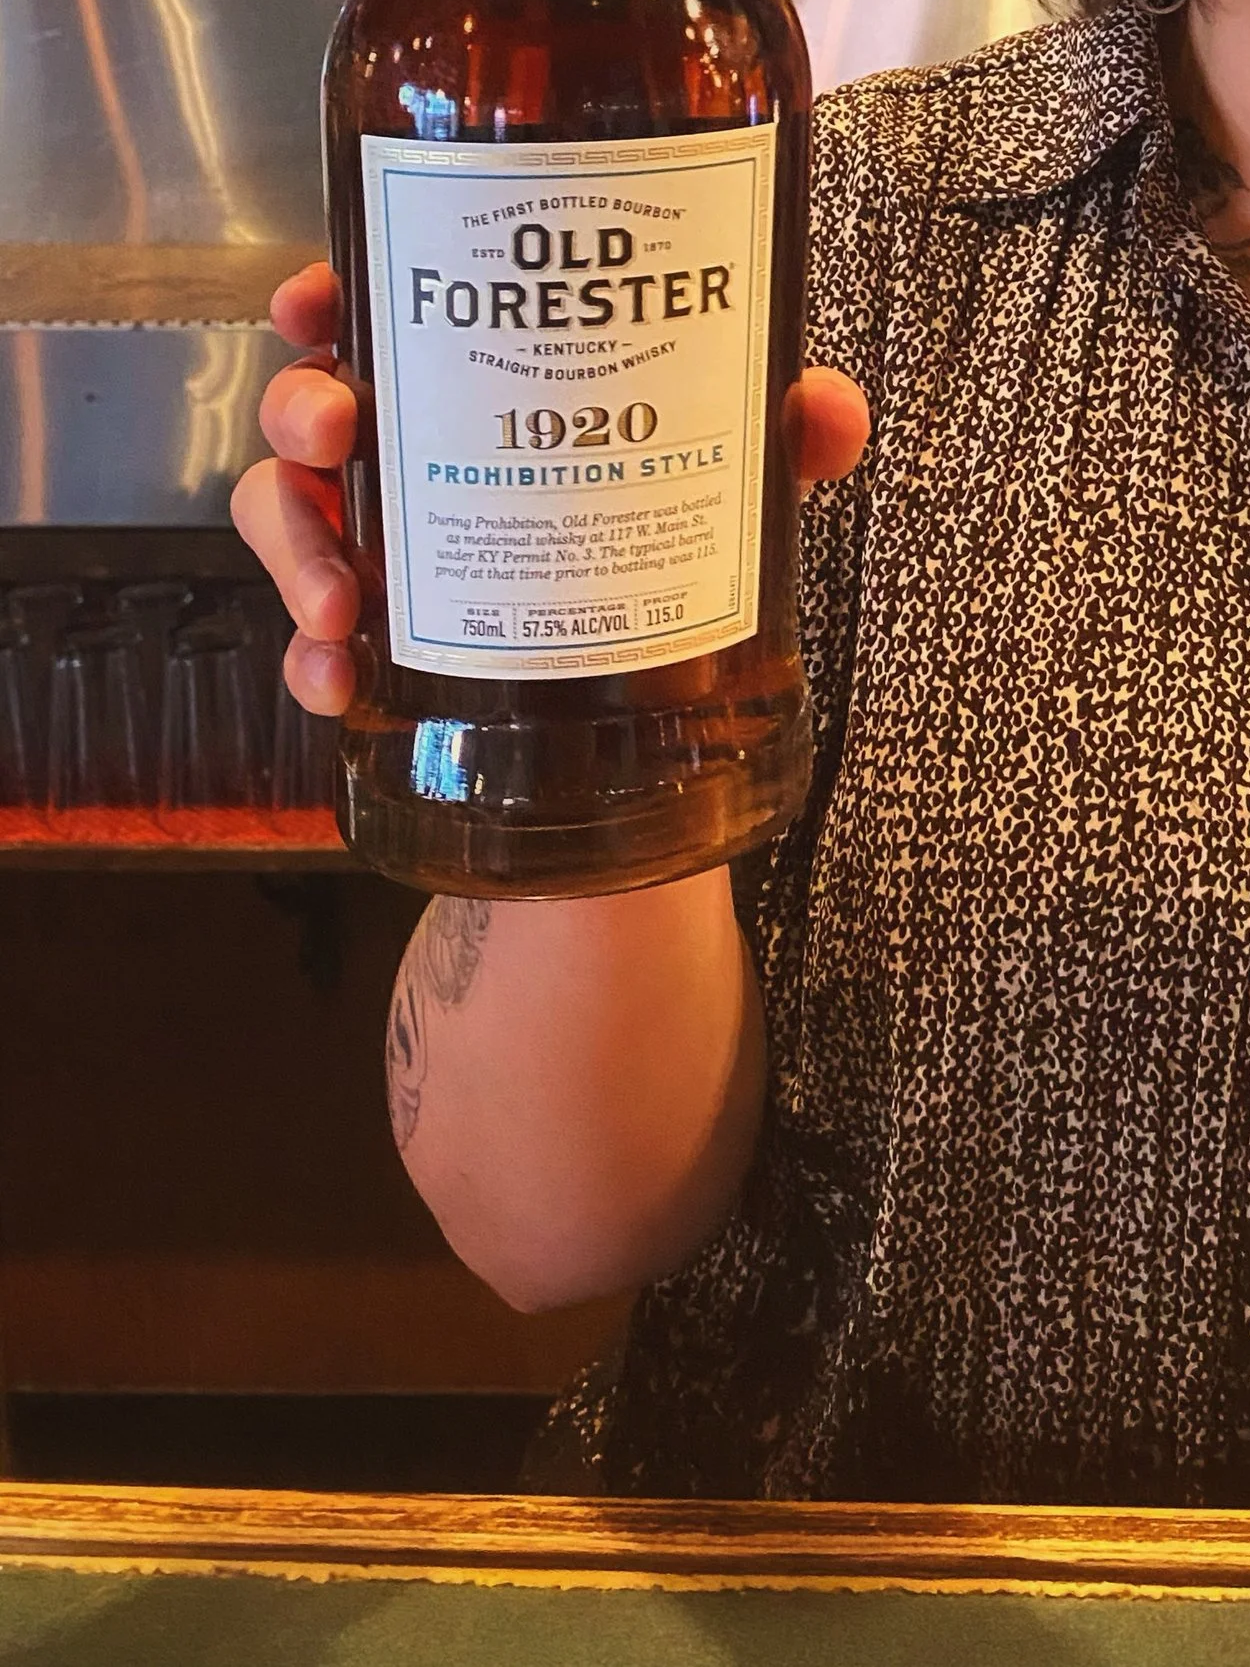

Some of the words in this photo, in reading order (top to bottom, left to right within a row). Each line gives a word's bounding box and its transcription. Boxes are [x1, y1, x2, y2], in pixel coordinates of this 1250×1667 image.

[461, 212, 491, 229] THE
[493, 200, 535, 223] FIRST
[539, 195, 608, 211] BOTTLED
[612, 198, 682, 222] BOURBON
[511, 221, 634, 272] OLD
[408, 264, 732, 330] FORESTER
[468, 350, 541, 380] STRAIGHT
[543, 361, 619, 381] BOURBON
[620, 340, 678, 370] WHISKY
[532, 339, 620, 357] KENTUCKY
[494, 401, 659, 451] 1920
[426, 460, 625, 487] PROHIBITION
[639, 443, 725, 479] STYLE
[427, 510, 472, 531] During
[474, 514, 558, 531] Prohibition,
[561, 513, 588, 529] Old
[591, 509, 651, 527] Forester
[652, 504, 678, 519] was
[681, 491, 722, 514] bottled
[435, 548, 475, 562] under
[477, 548, 499, 564] KY
[502, 549, 551, 564] Permit
[599, 545, 627, 560] The
[629, 537, 677, 558] typical
[678, 526, 715, 548] barrel
[446, 533, 460, 545] as
[463, 533, 532, 547] medicinal
[535, 531, 586, 548] whisky
[589, 530, 604, 544] at
[654, 517, 689, 536] Main
[434, 564, 470, 581] proof
[470, 566, 483, 580] at
[486, 566, 515, 581] that
[518, 566, 551, 580] time
[553, 563, 590, 582] prior
[593, 563, 609, 577] to
[611, 555, 666, 575] bottling
[668, 551, 694, 565] was
[522, 619, 568, 639] 57.5%
[570, 611, 631, 636] ALC/VOL
[646, 602, 685, 627] 115.0
[527, 602, 627, 618] PERCENTAGE
[642, 590, 689, 607] PROOF
